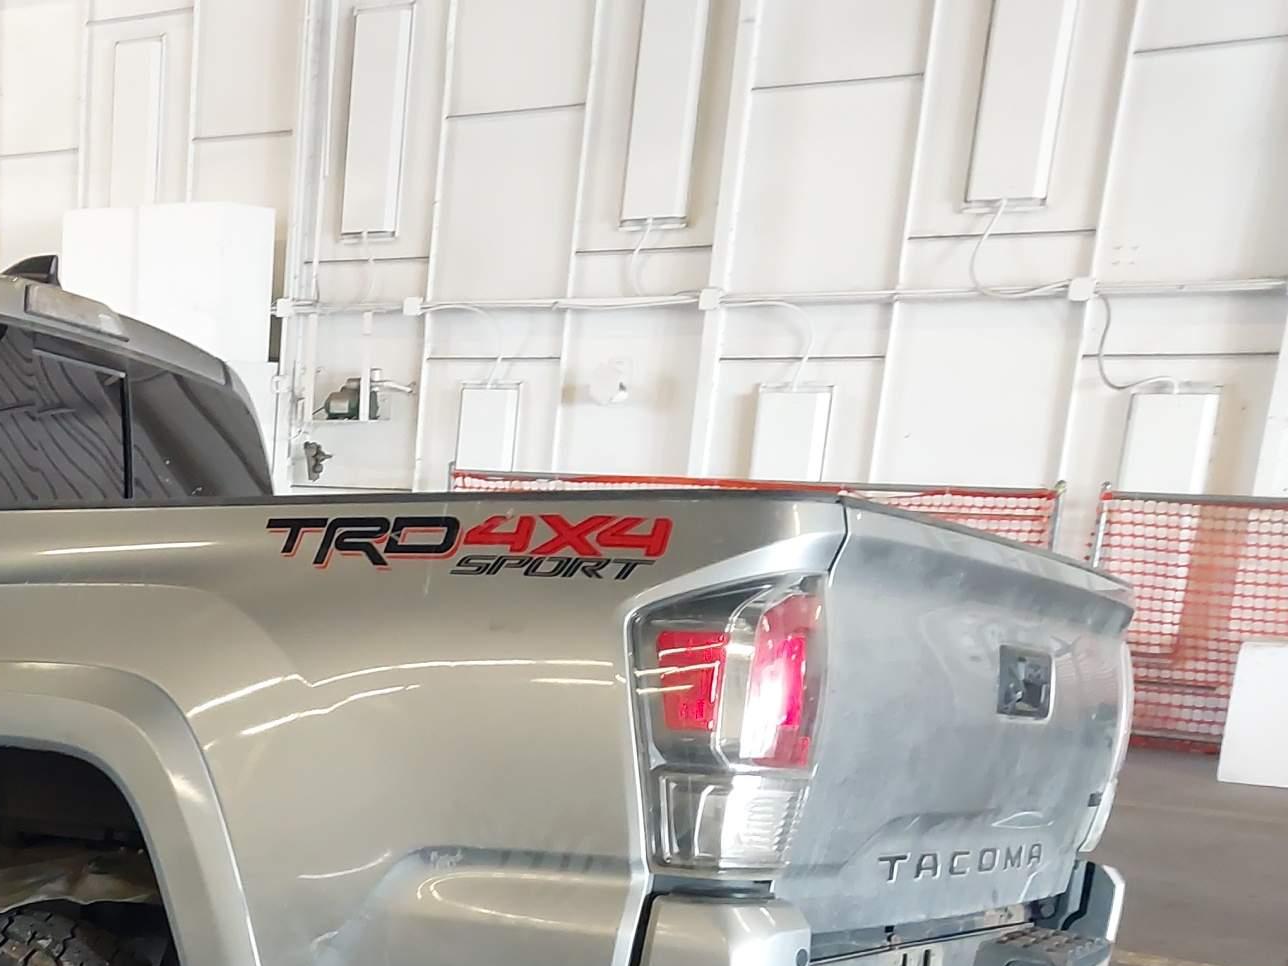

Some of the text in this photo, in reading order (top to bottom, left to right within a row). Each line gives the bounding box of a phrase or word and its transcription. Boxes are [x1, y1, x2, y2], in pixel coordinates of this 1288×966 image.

[266, 514, 673, 571] TRD 4X4
[449, 554, 656, 581] SPORT
[877, 842, 1043, 884] TACOMA
